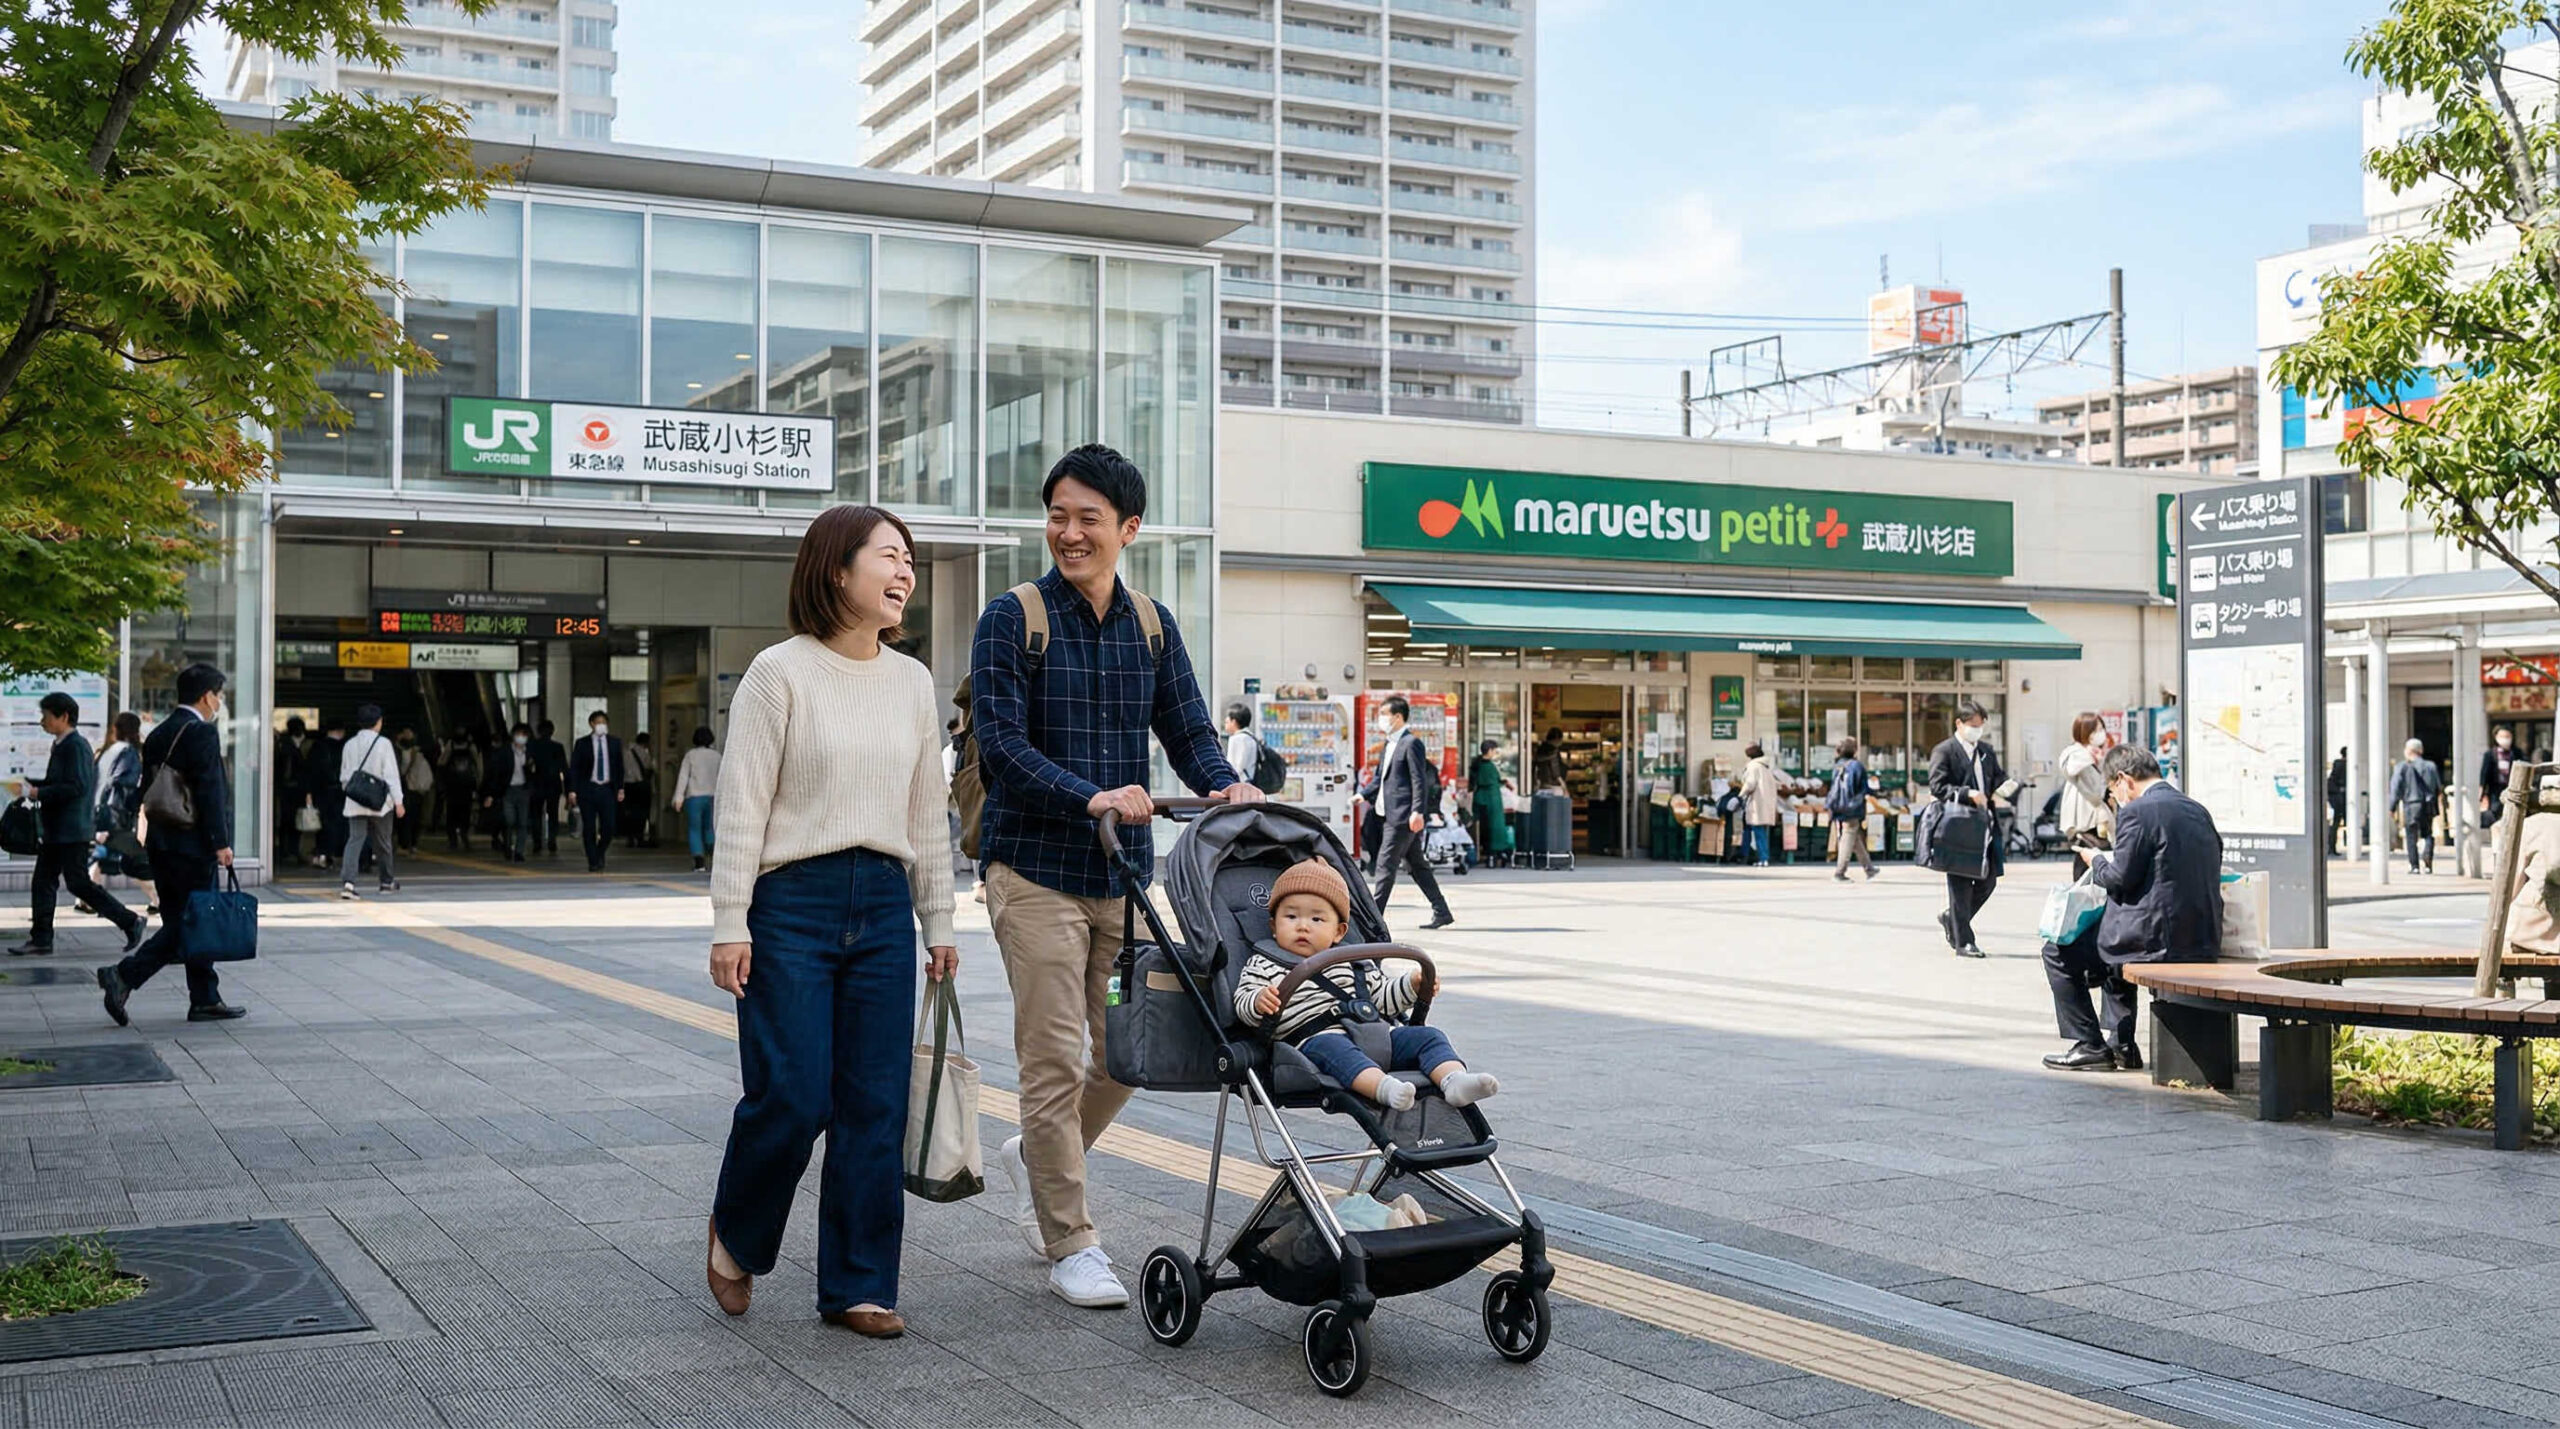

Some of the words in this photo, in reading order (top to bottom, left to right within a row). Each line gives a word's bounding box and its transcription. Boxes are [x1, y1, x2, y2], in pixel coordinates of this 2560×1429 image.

[464, 409, 540, 452] JR
[643, 418, 812, 459] 武蔵小杉駅
[568, 453, 625, 472] 東急線
[643, 456, 748, 479] Musashisugi
[753, 461, 810, 479] Station
[2218, 490, 2297, 518] バス乗り場
[1514, 499, 1711, 542] maruetsu
[1720, 502, 1812, 553] petit
[1862, 521, 1975, 557] 武蔵小杉店
[2218, 548, 2294, 573] バス乗り場
[2218, 597, 2302, 623] タクシー乗り場
[556, 617, 600, 636] 12:45
